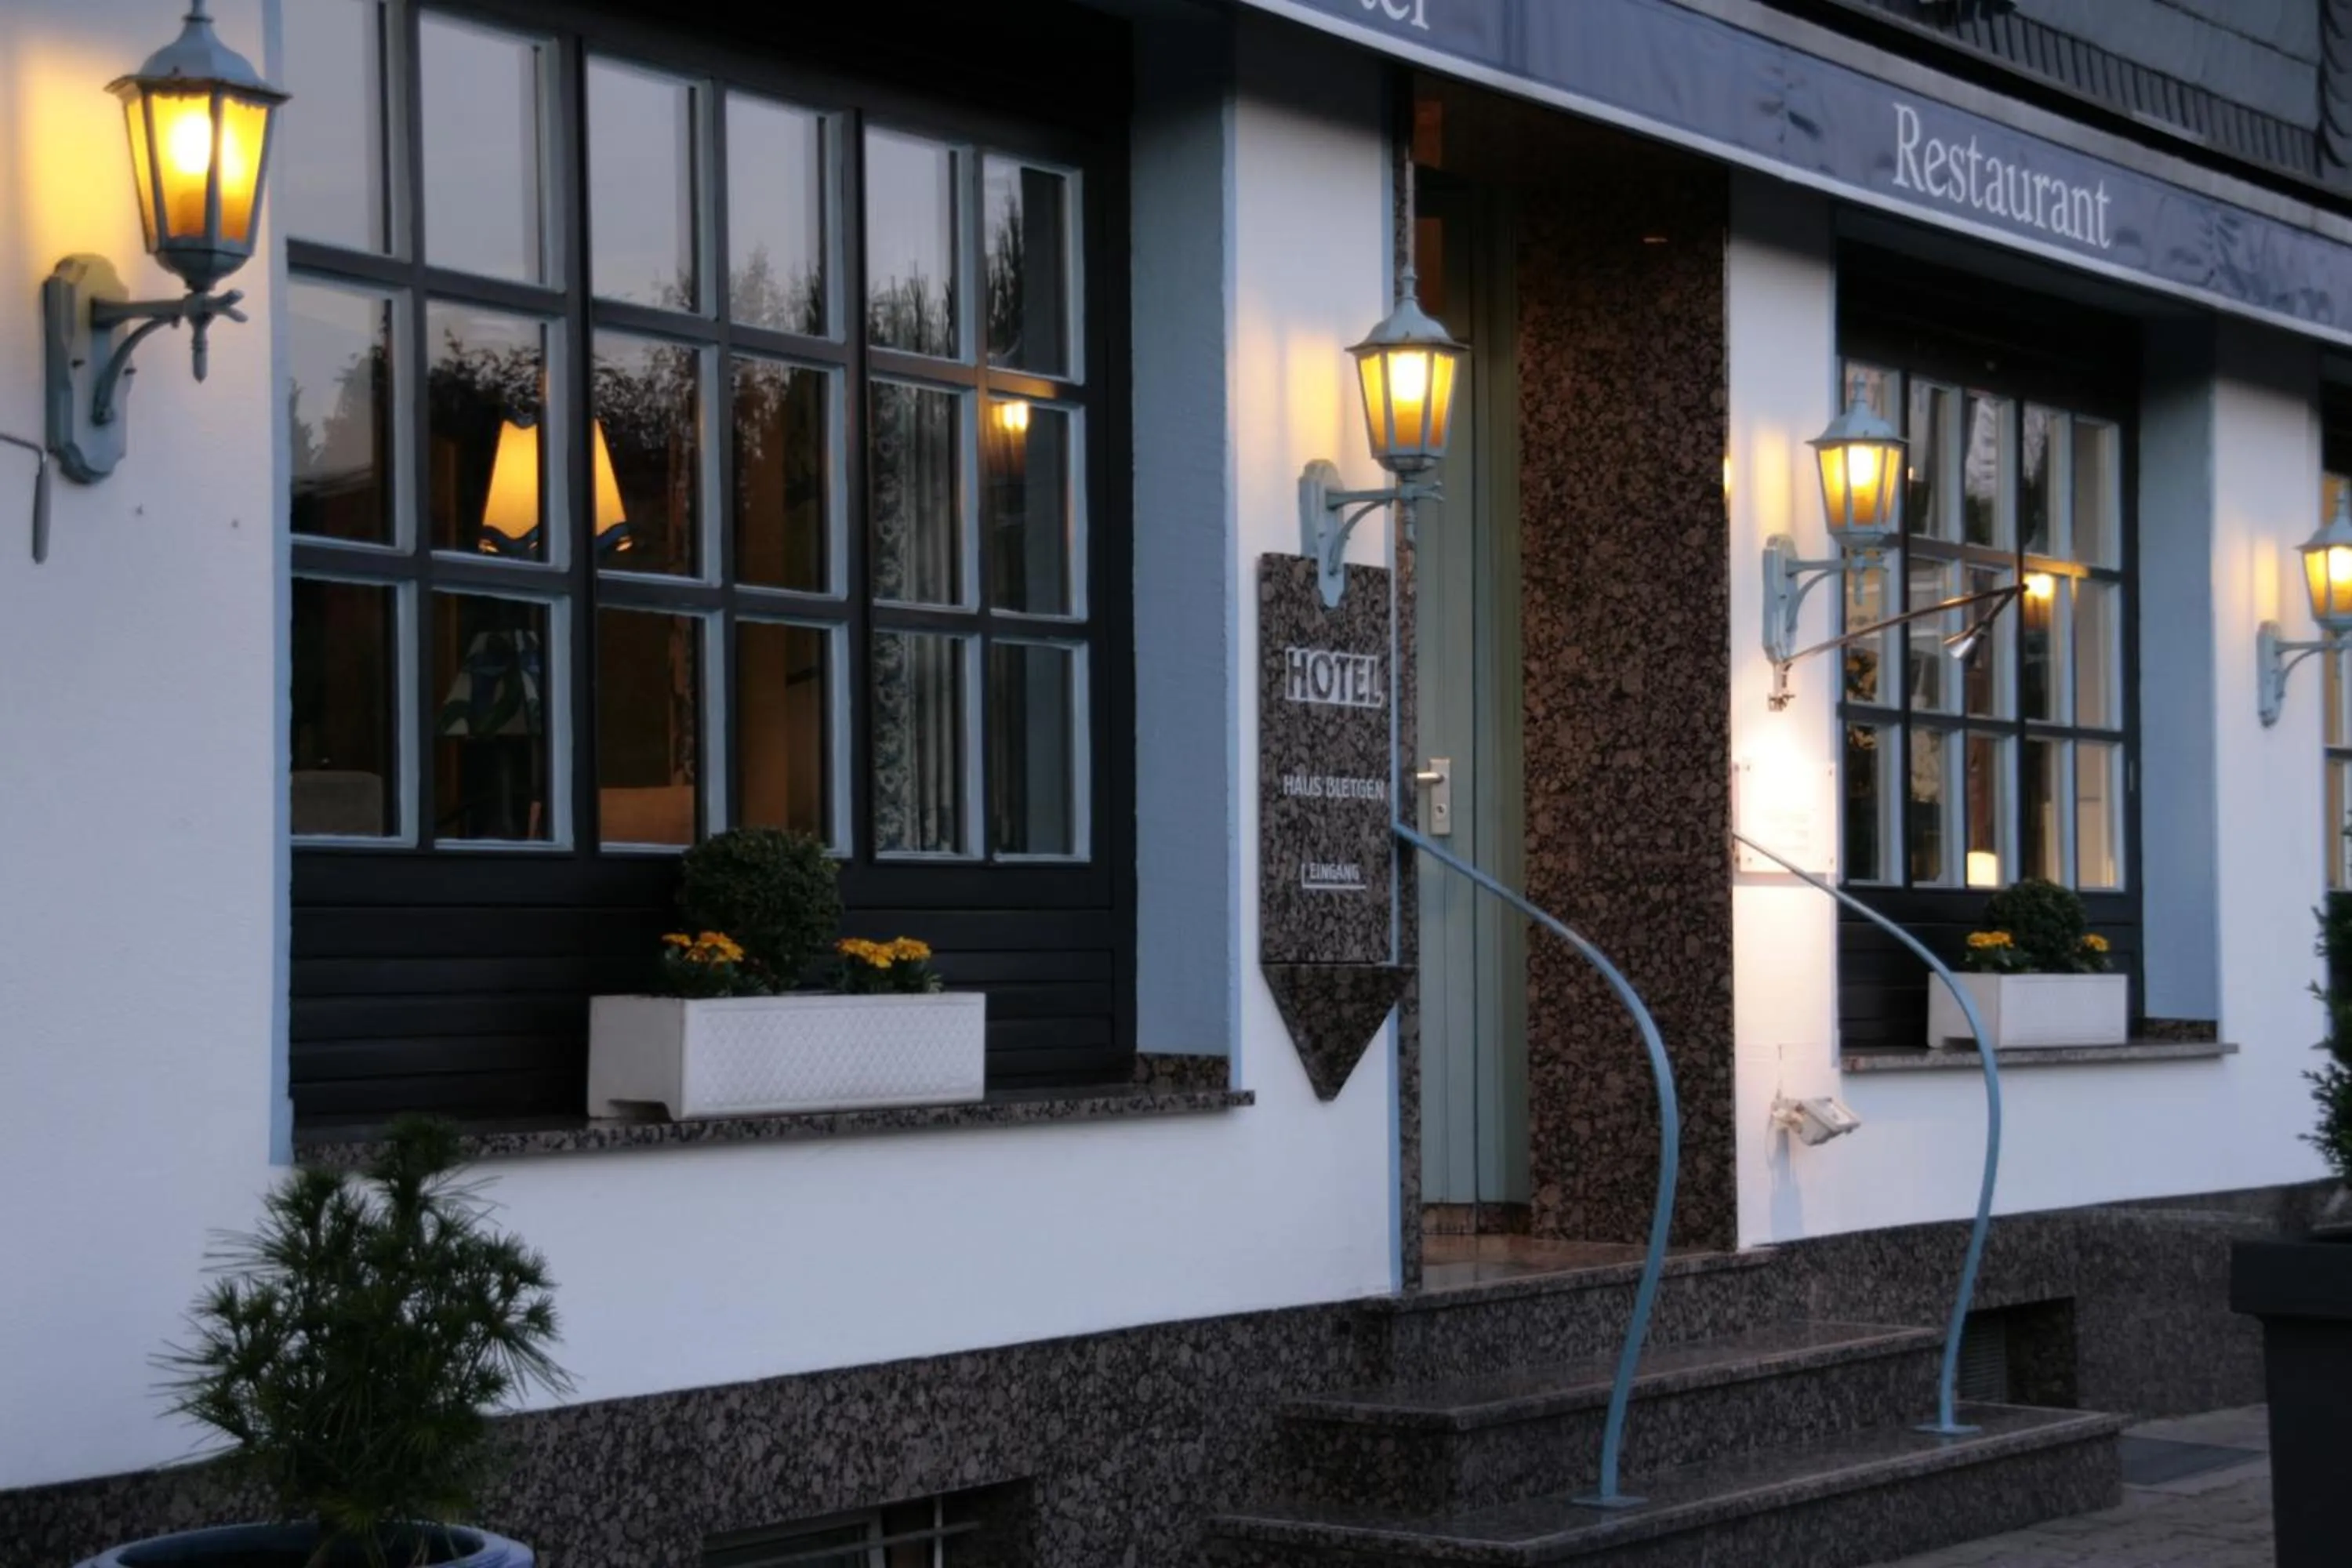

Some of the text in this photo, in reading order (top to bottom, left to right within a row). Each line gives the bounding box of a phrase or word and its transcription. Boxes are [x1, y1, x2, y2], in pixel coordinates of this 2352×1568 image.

[1892, 102, 2112, 249] Restaurant
[1285, 646, 1384, 708] HOTEL
[1283, 775, 1322, 797] HAUS
[1309, 862, 1359, 880] EINGANG
